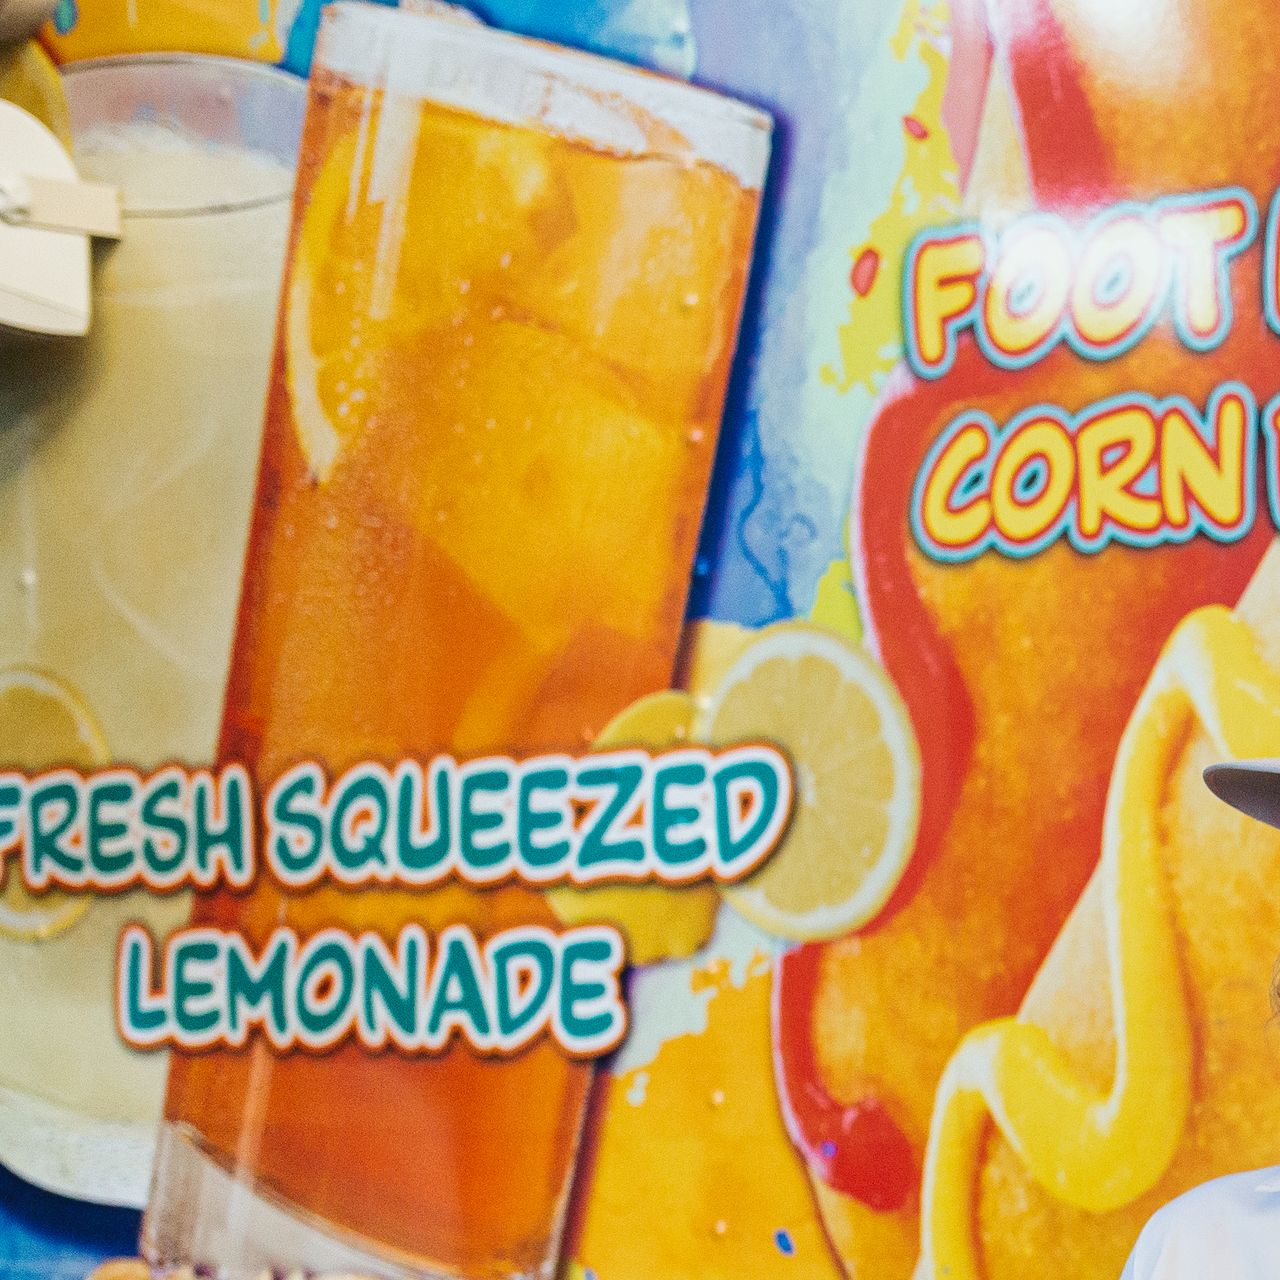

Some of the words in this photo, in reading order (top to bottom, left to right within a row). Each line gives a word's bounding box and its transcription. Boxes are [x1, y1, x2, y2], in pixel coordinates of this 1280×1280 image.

[910, 196, 1253, 372] FOOT
[919, 385, 1250, 556] CORN
[265, 753, 784, 876] SQUEEZED
[124, 931, 620, 1040] LEMONADE
